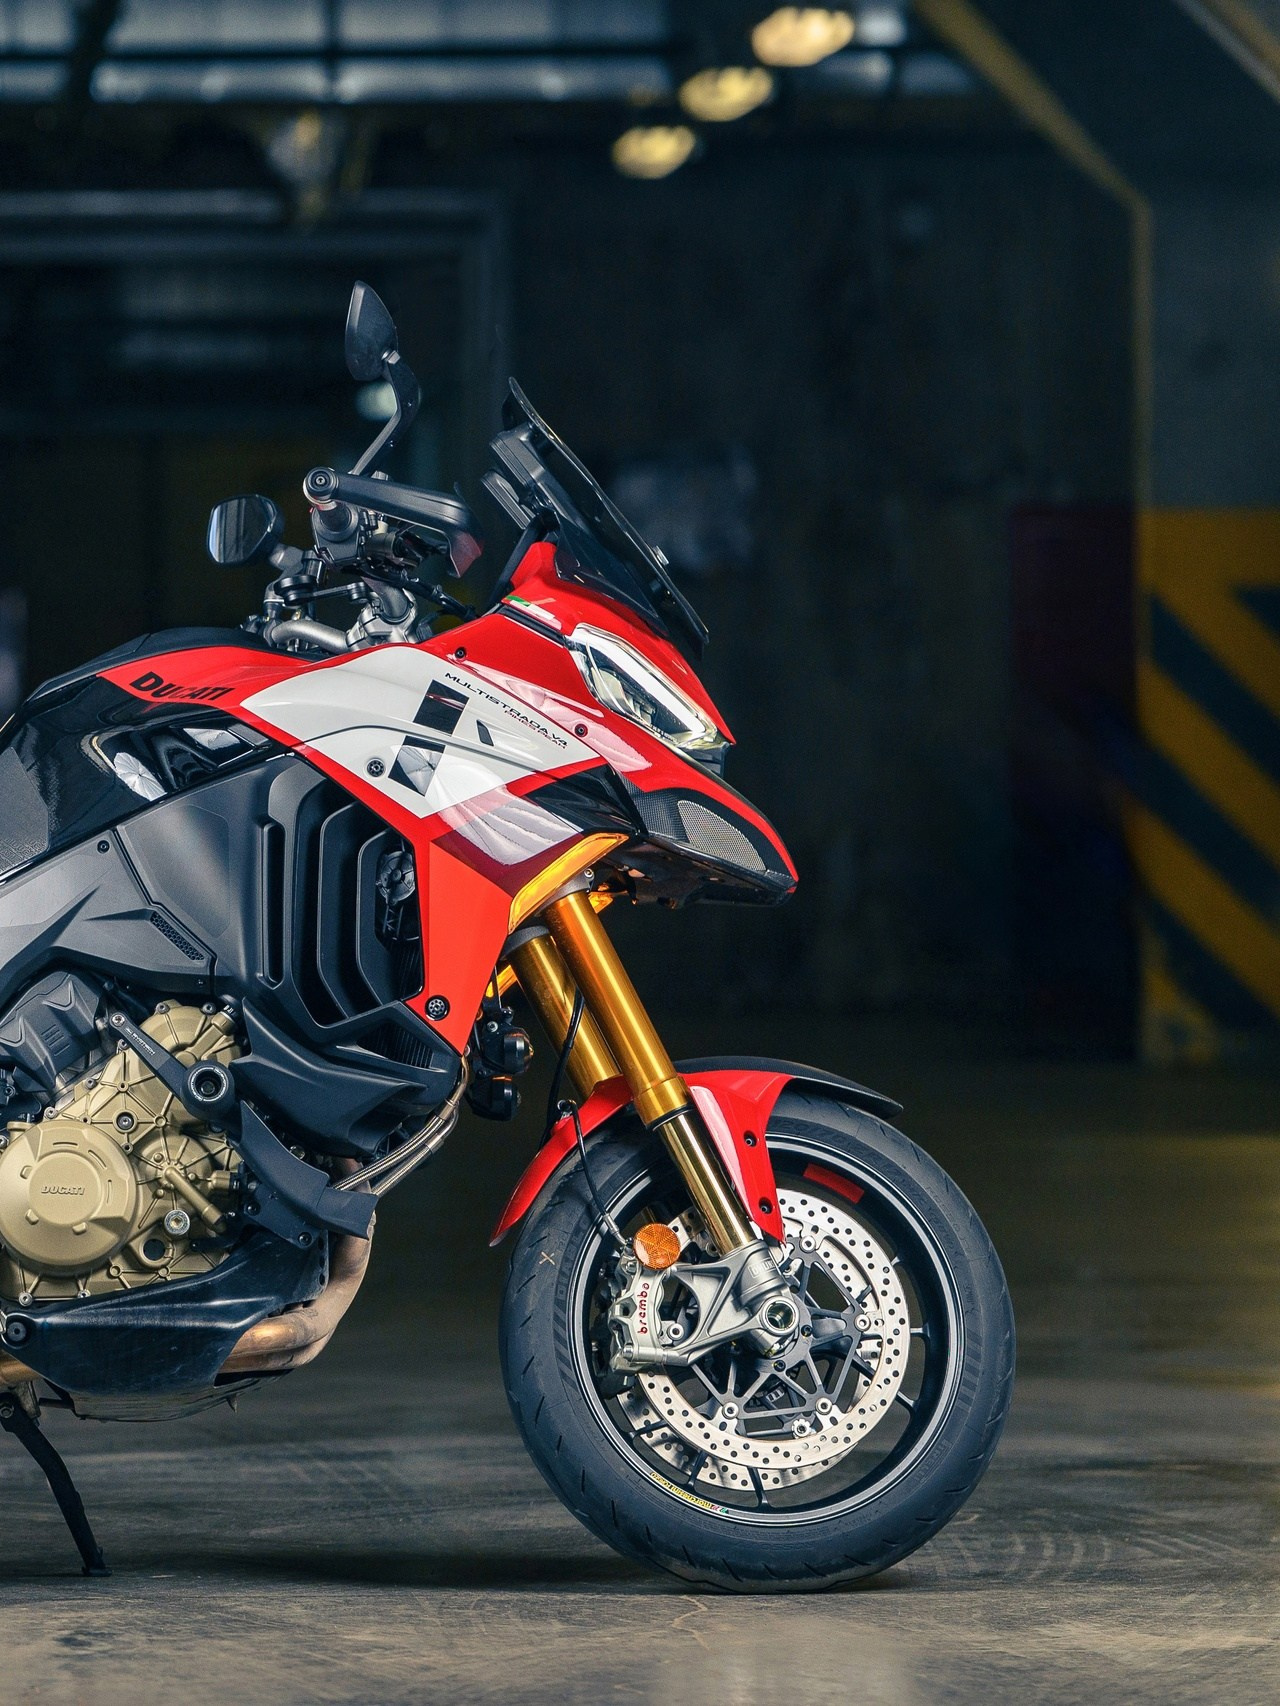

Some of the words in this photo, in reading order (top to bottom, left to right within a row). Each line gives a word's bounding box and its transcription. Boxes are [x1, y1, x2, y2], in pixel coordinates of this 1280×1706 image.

[129, 671, 236, 700] DUCATI
[445, 672, 548, 734] MULTISTRADA
[552, 732, 568, 747] V4
[41, 1185, 86, 1196] DUCATI
[636, 1282, 650, 1334] brembo
